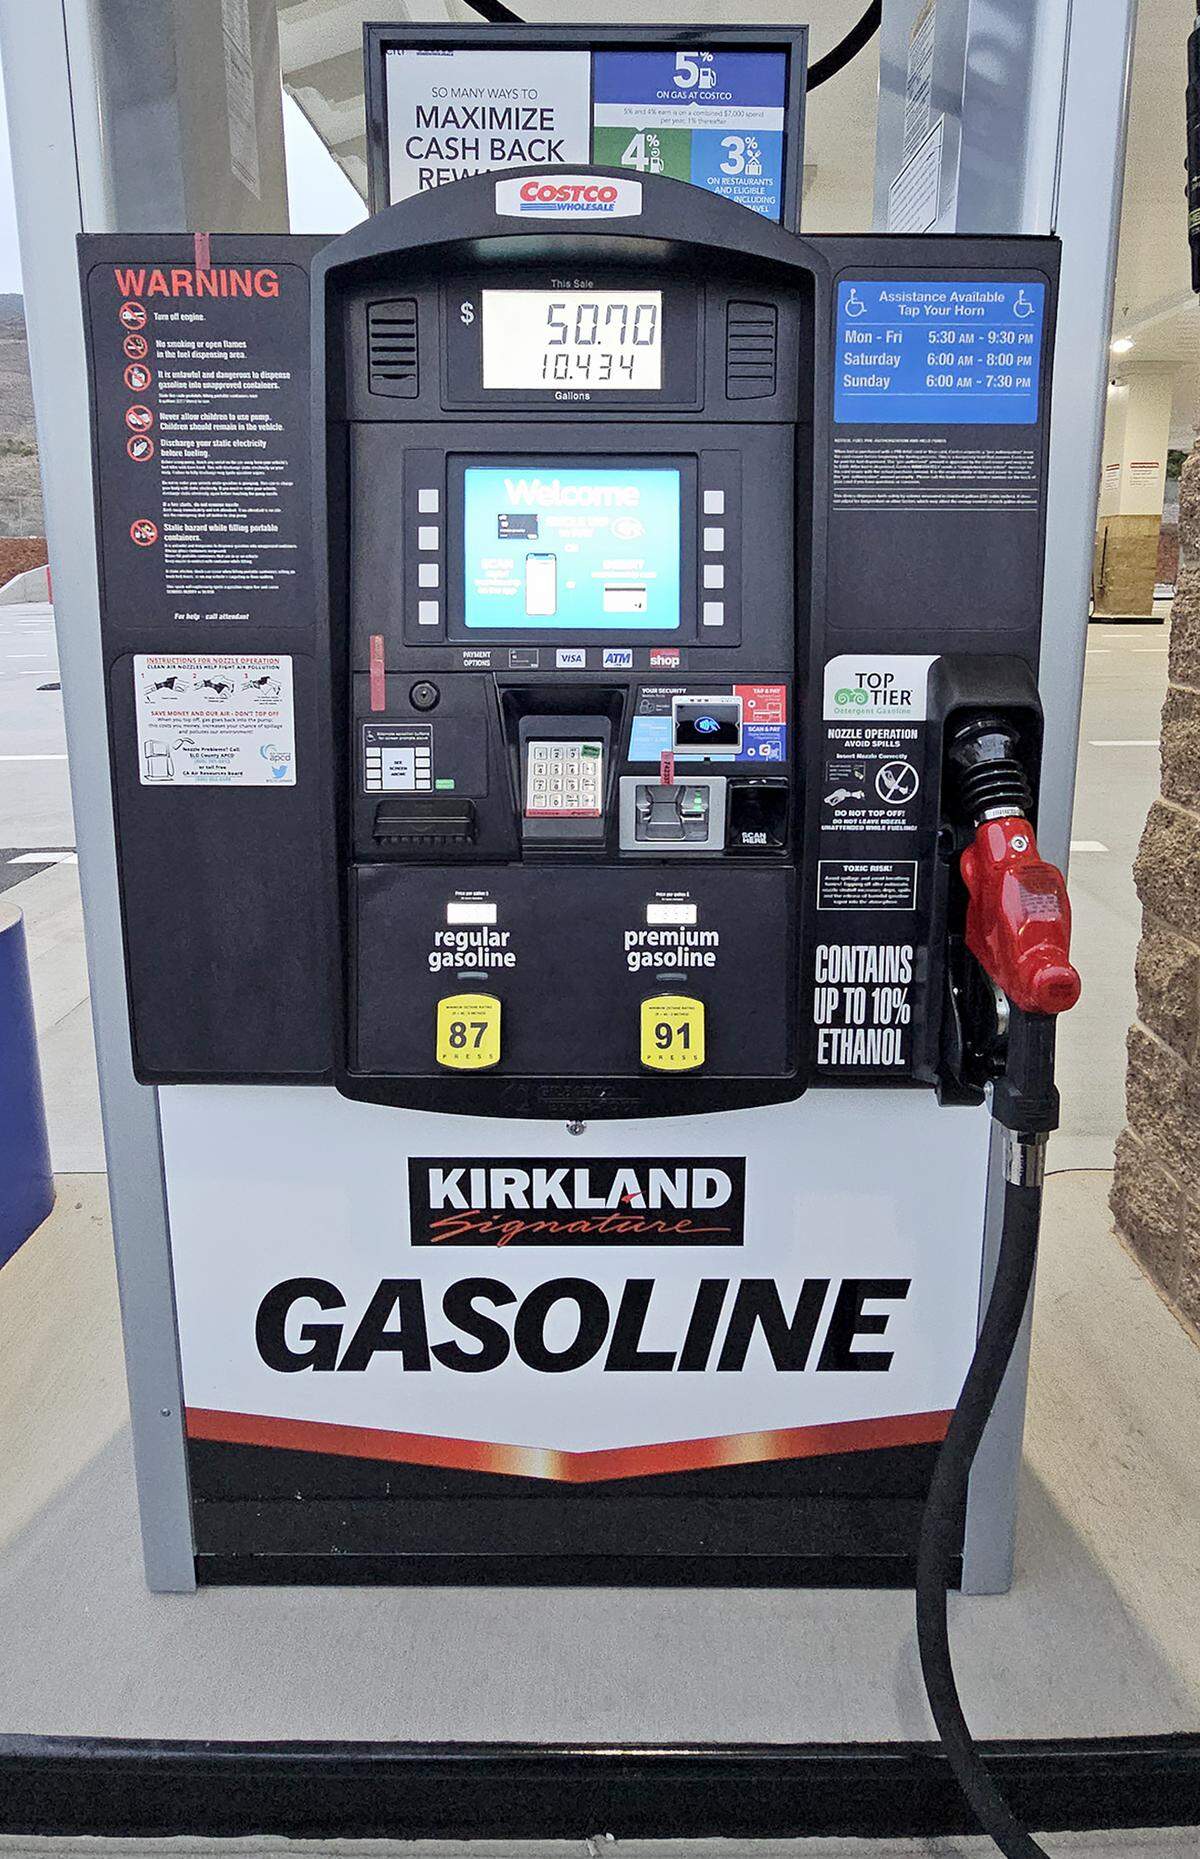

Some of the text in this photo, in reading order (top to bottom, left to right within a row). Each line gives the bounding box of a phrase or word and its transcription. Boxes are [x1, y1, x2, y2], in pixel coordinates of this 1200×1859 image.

[432, 86, 538, 100] SO MANY WAYS TO
[656, 91, 732, 100] ON GAS AT COSTCO
[416, 106, 555, 131] MAXIMIZE
[405, 137, 566, 162] CASH BACK
[520, 182, 618, 202] COSTCO
[707, 178, 774, 186] ON RESTAURANTS
[715, 187, 766, 195] AND ELIGIBLE
[557, 202, 616, 211] WHOLESALE
[114, 269, 280, 298] WARNING
[551, 280, 594, 289] This Sale
[879, 290, 1005, 303] Assistance Available
[460, 302, 475, 325] $
[898, 304, 984, 317] Tap Your Horn
[547, 304, 657, 345] 50.70
[844, 331, 872, 344] Mon
[886, 331, 902, 344] Fri
[928, 331, 956, 344] 5:30
[958, 334, 974, 344] AM
[988, 331, 1014, 344] 9:30
[1018, 334, 1033, 344] PM
[543, 354, 634, 380] 10.434
[844, 353, 901, 368] Saturday
[927, 353, 954, 366] 6:00
[958, 356, 974, 366] AM
[986, 353, 1014, 366] 8:00
[1016, 356, 1032, 366] PM
[844, 375, 891, 390] Sunday
[926, 375, 953, 388] 6:00
[956, 378, 972, 388] AM
[986, 375, 1012, 388] 7:30
[1016, 378, 1030, 388] PM
[554, 392, 590, 400] Gallons
[504, 480, 640, 507] Welcome
[186, 613, 200, 621] help
[604, 653, 630, 664] ATM
[650, 656, 680, 668] shop
[855, 673, 894, 688] TOP
[870, 690, 910, 706] TIER
[828, 728, 918, 739] NOZZLE OPERATION
[434, 926, 510, 952] regular
[624, 926, 720, 952] premium
[428, 948, 516, 972] gasoline
[627, 948, 716, 972] gasoline
[815, 945, 913, 984] CONTAINS
[814, 987, 910, 1025] UP TO 10%
[449, 1022, 488, 1048] 87
[655, 1022, 691, 1050] 91
[817, 1028, 905, 1066] ETHANOL
[428, 1168, 732, 1208] KIRKLAND
[430, 1209, 731, 1248] Signature
[255, 1276, 912, 1374] GASOLINE
